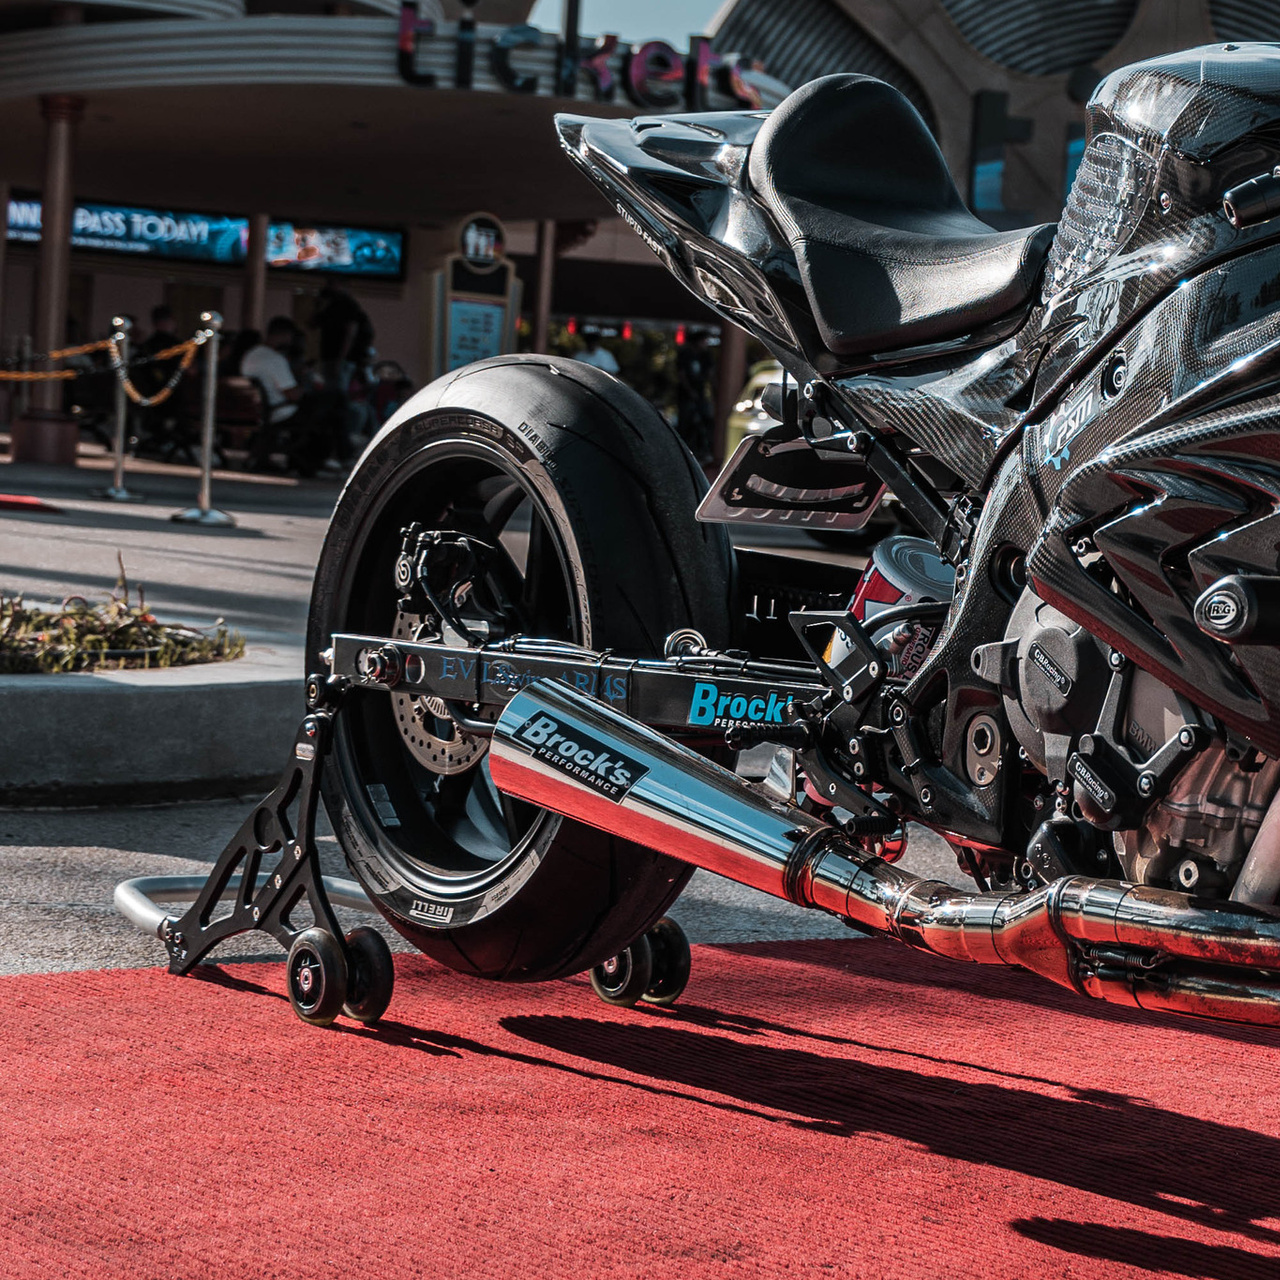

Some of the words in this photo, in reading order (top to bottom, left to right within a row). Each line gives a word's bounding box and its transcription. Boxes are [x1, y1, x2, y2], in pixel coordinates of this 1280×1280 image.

[75, 207, 126, 236] PASS
[616, 202, 643, 236] STUPID
[642, 231, 663, 255] FAST
[688, 682, 793, 726] Brock'
[1128, 720, 1157, 753] BMW
[538, 747, 619, 795] PERFORMANCE
[409, 900, 455, 924] PIRELLI
